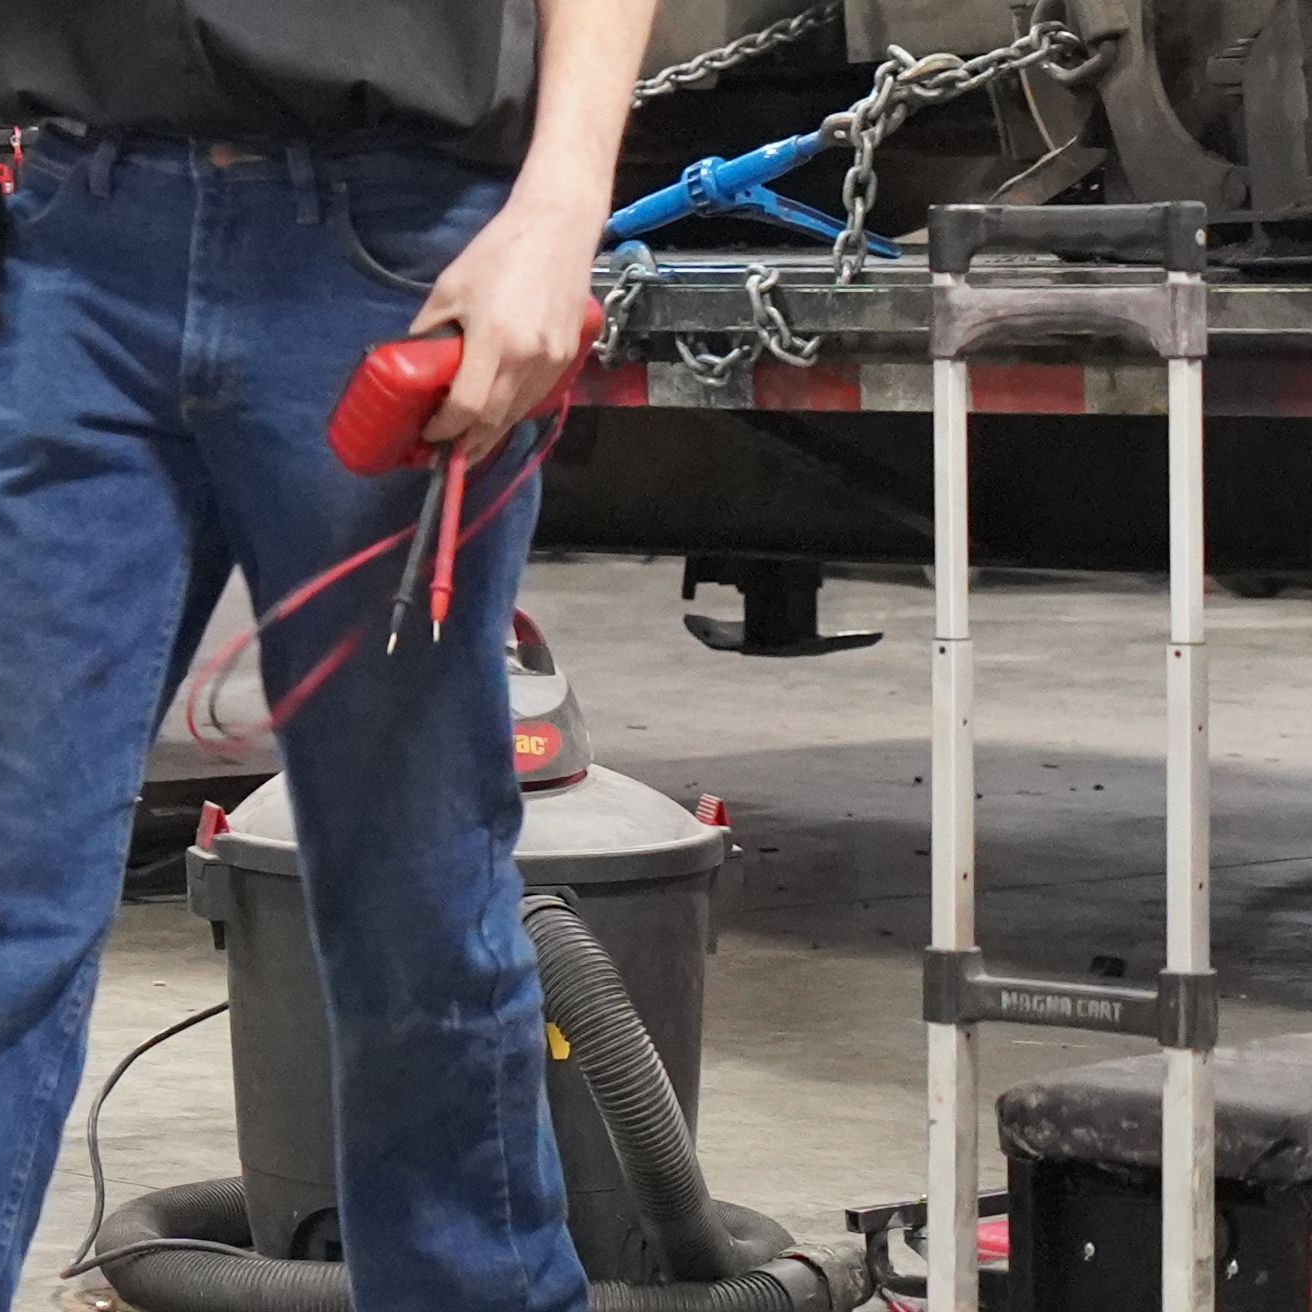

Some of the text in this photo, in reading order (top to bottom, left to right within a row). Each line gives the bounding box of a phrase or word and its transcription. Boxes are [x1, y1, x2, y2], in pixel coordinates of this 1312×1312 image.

[514, 734, 546, 756] ac
[1001, 990, 1123, 1023] MAGNA CART
